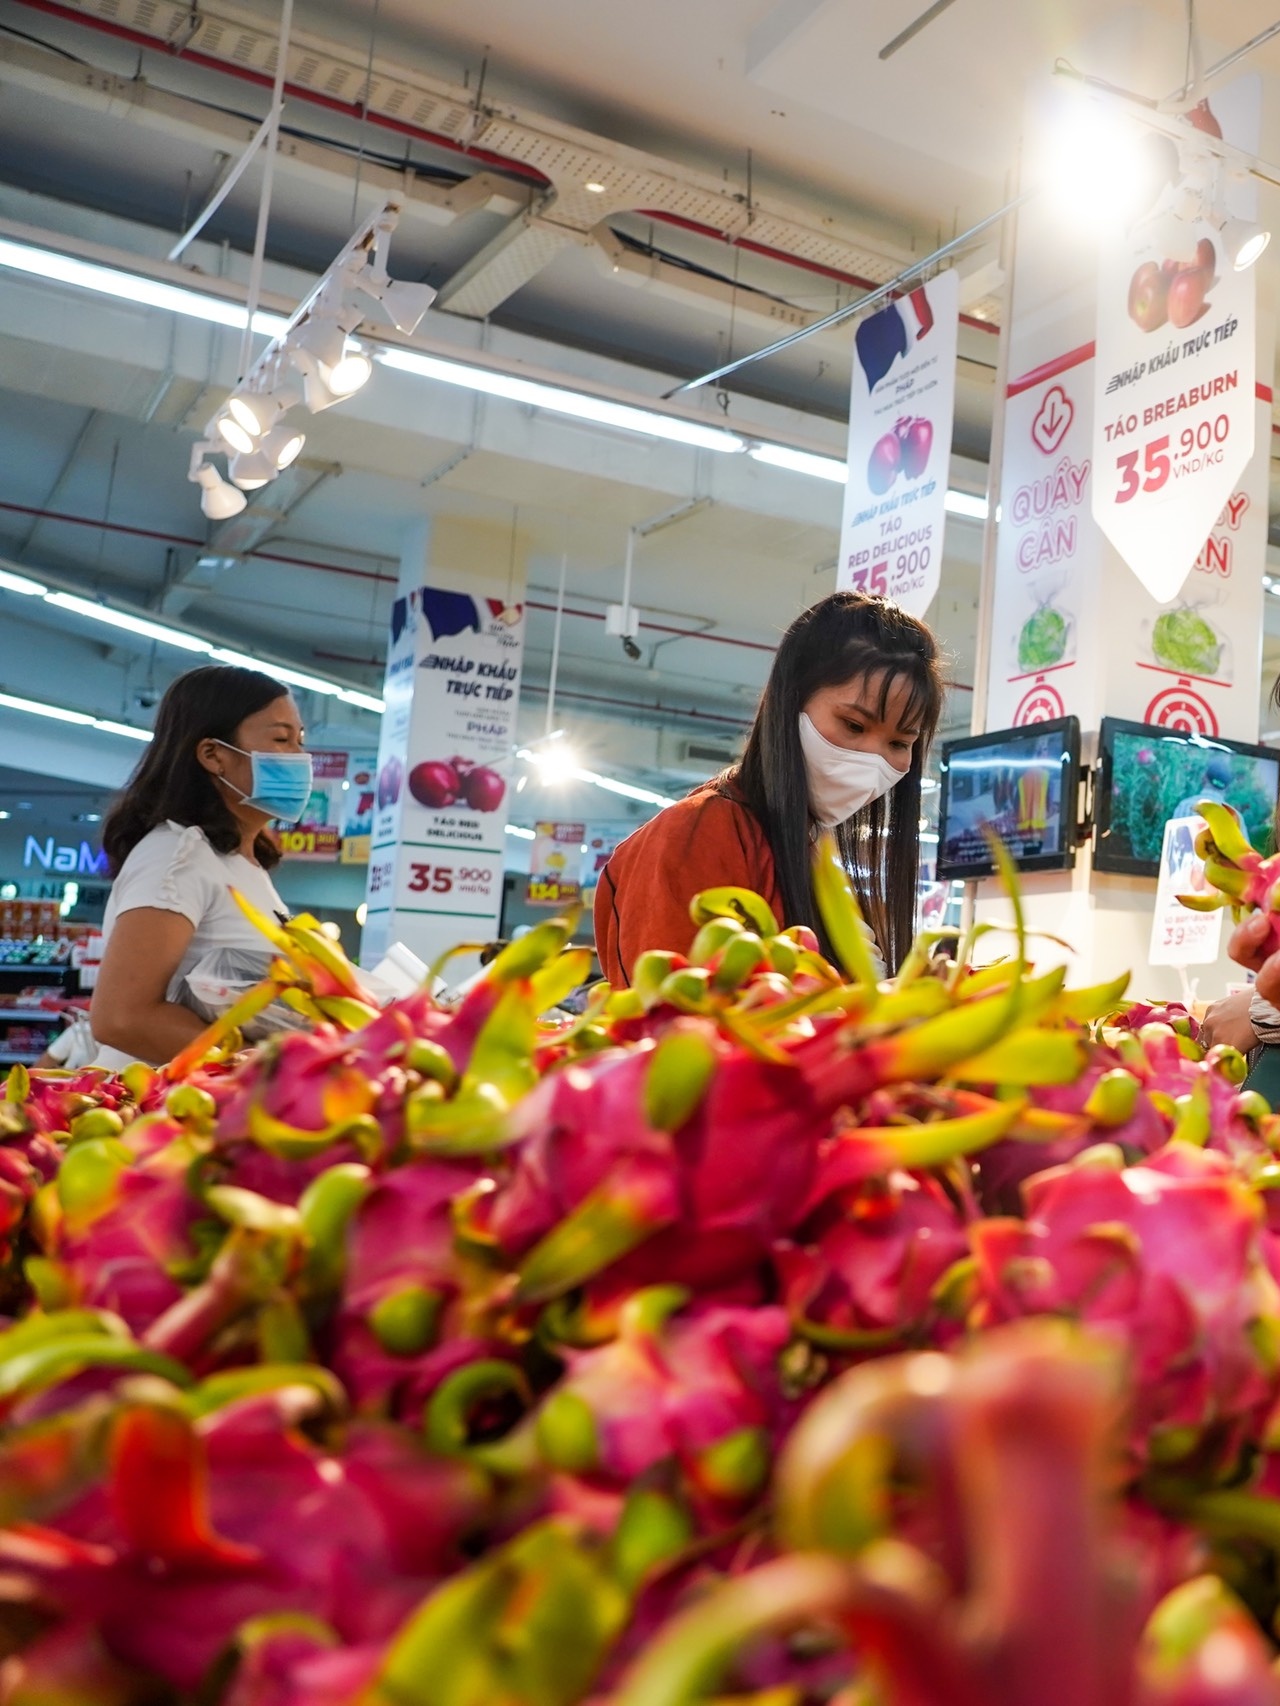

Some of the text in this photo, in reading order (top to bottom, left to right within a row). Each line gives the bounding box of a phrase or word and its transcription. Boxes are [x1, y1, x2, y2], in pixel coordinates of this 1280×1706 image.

[1115, 313, 1239, 388] NHẬP KHẨU TRỰC TIẾP
[1104, 370, 1238, 443] TÁO BREABURN
[1173, 449, 1224, 479] VND/KG
[848, 525, 932, 569] RED DELICIOUS
[880, 515, 902, 536] TÁO
[1017, 518, 1076, 571] CÂN
